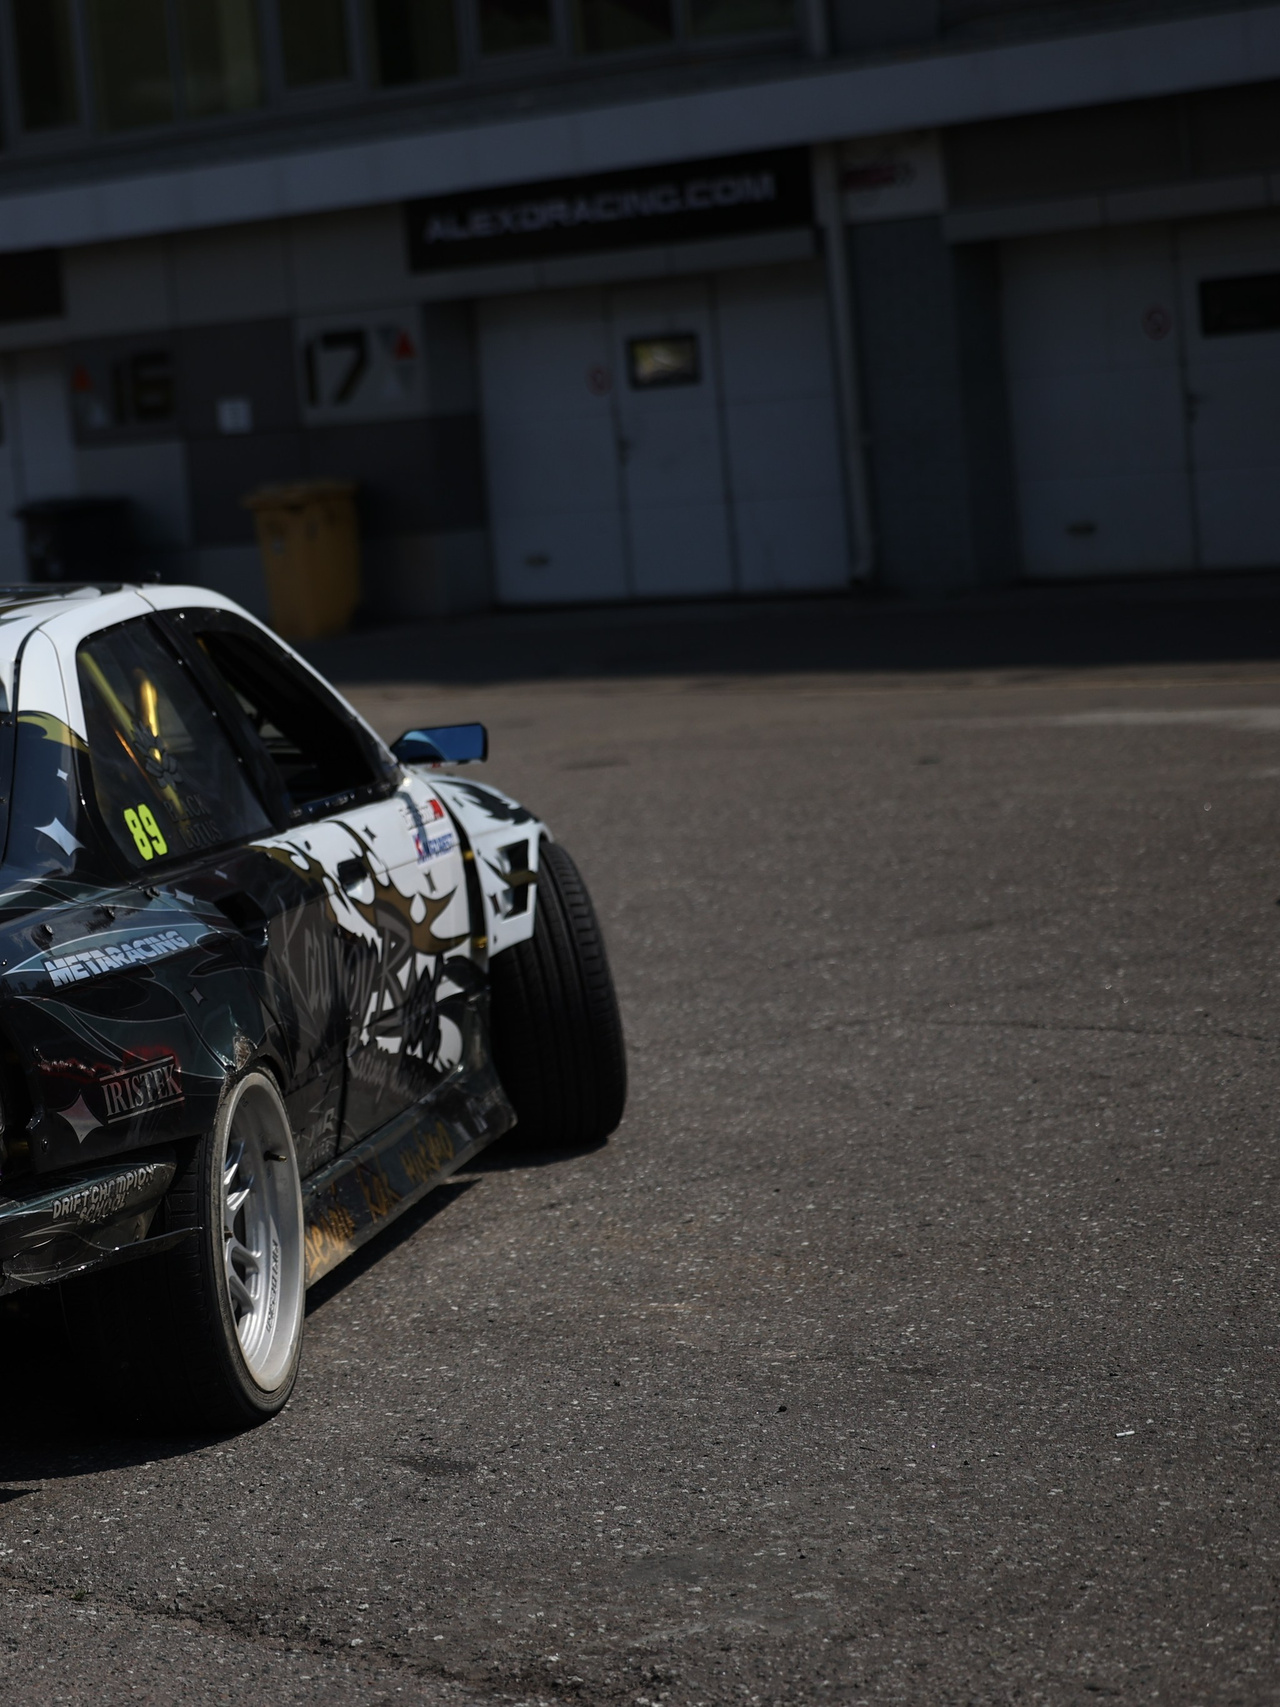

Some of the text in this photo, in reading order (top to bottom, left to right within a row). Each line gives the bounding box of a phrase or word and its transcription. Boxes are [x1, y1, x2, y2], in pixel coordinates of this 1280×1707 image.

[305, 331, 366, 407] 17
[123, 803, 168, 861] 89
[43, 930, 191, 988] METARACING
[101, 1064, 183, 1117] IRISTEK
